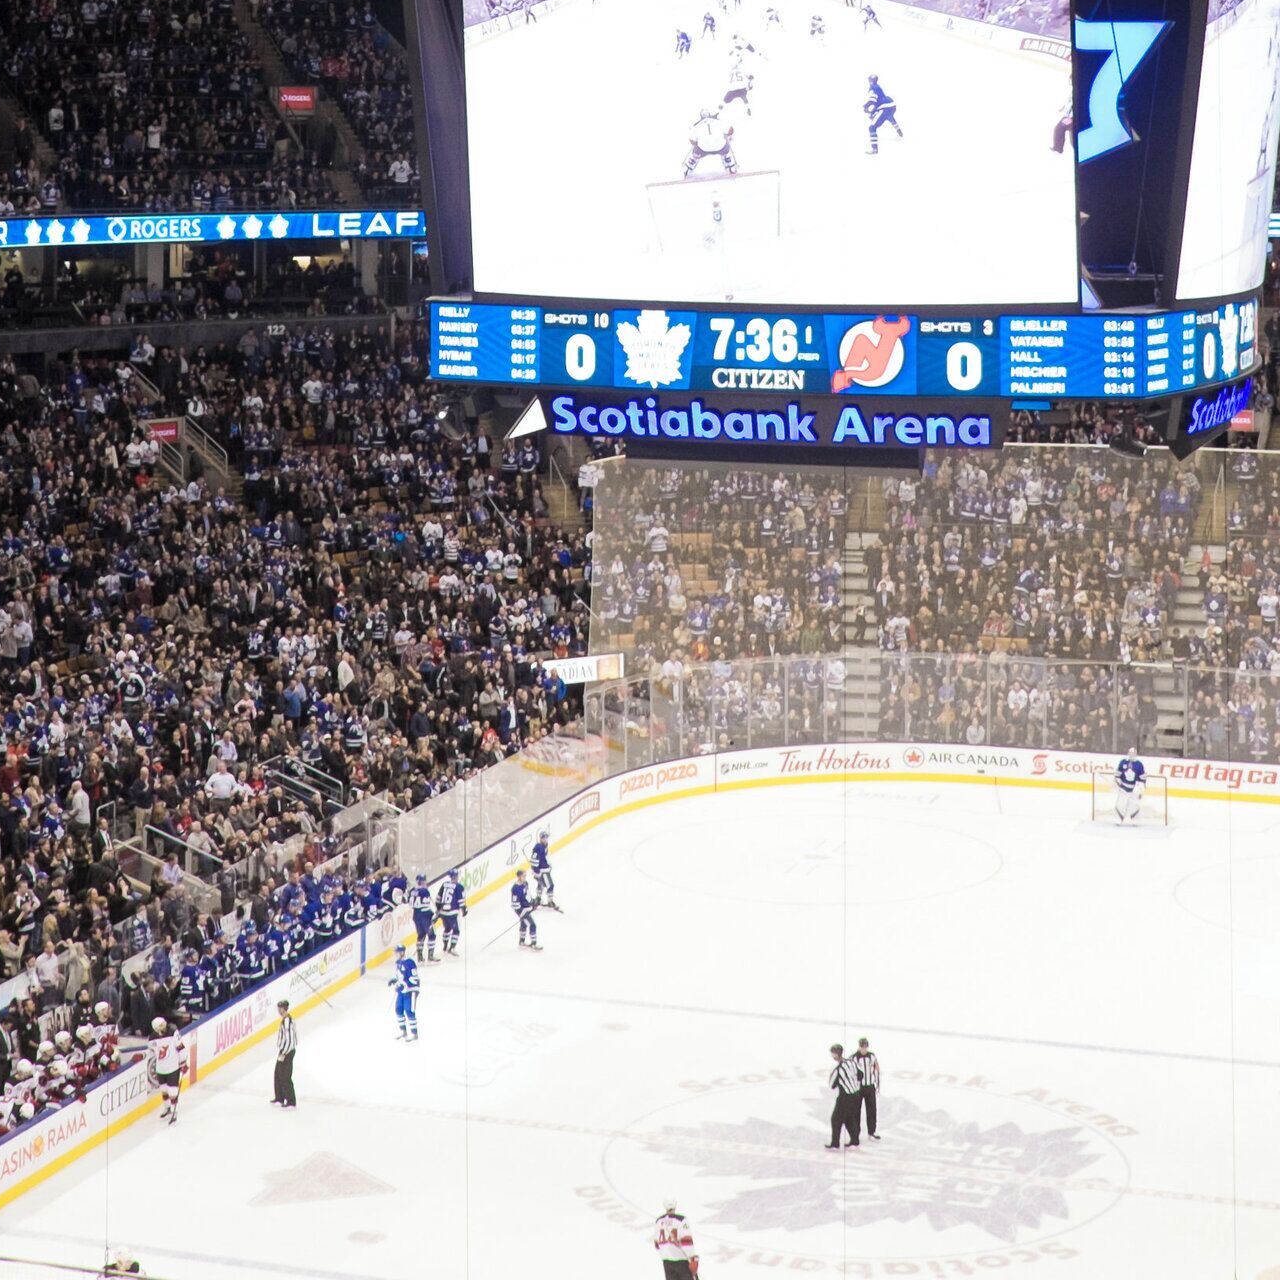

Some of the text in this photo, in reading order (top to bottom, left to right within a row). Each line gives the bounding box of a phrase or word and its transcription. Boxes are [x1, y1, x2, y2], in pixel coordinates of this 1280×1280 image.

[482, 21, 500, 37] AVIS
[287, 94, 311, 102] ROGERS
[131, 218, 201, 238] ROGERS
[312, 212, 426, 236] LEAF
[267, 325, 286, 336] 122
[544, 313, 609, 328] SHOTS 10
[920, 320, 993, 336] SHOTS 3
[1010, 320, 1067, 332] MUELLER
[711, 318, 798, 362] 7:36
[1009, 336, 1063, 347] VATANEN
[565, 333, 596, 381] 0
[1010, 351, 1042, 363] HALL
[1203, 332, 1215, 379] 0
[946, 341, 982, 391] 0
[1010, 367, 1067, 378] HISCHIER
[712, 368, 805, 390] CITIZEN
[1010, 382, 1066, 394] PALMIERI
[552, 397, 990, 445] Scotiabank Arena
[779, 748, 891, 772] Tim Hortons
[928, 751, 1019, 768] AIR CANADA
[620, 763, 699, 800] pizza pizza
[442, 886, 454, 905] 16
[214, 1005, 253, 1055] JAMAICA
[1009, 1085, 1140, 1138] Arena
[47, 1112, 87, 1150] RAMA
